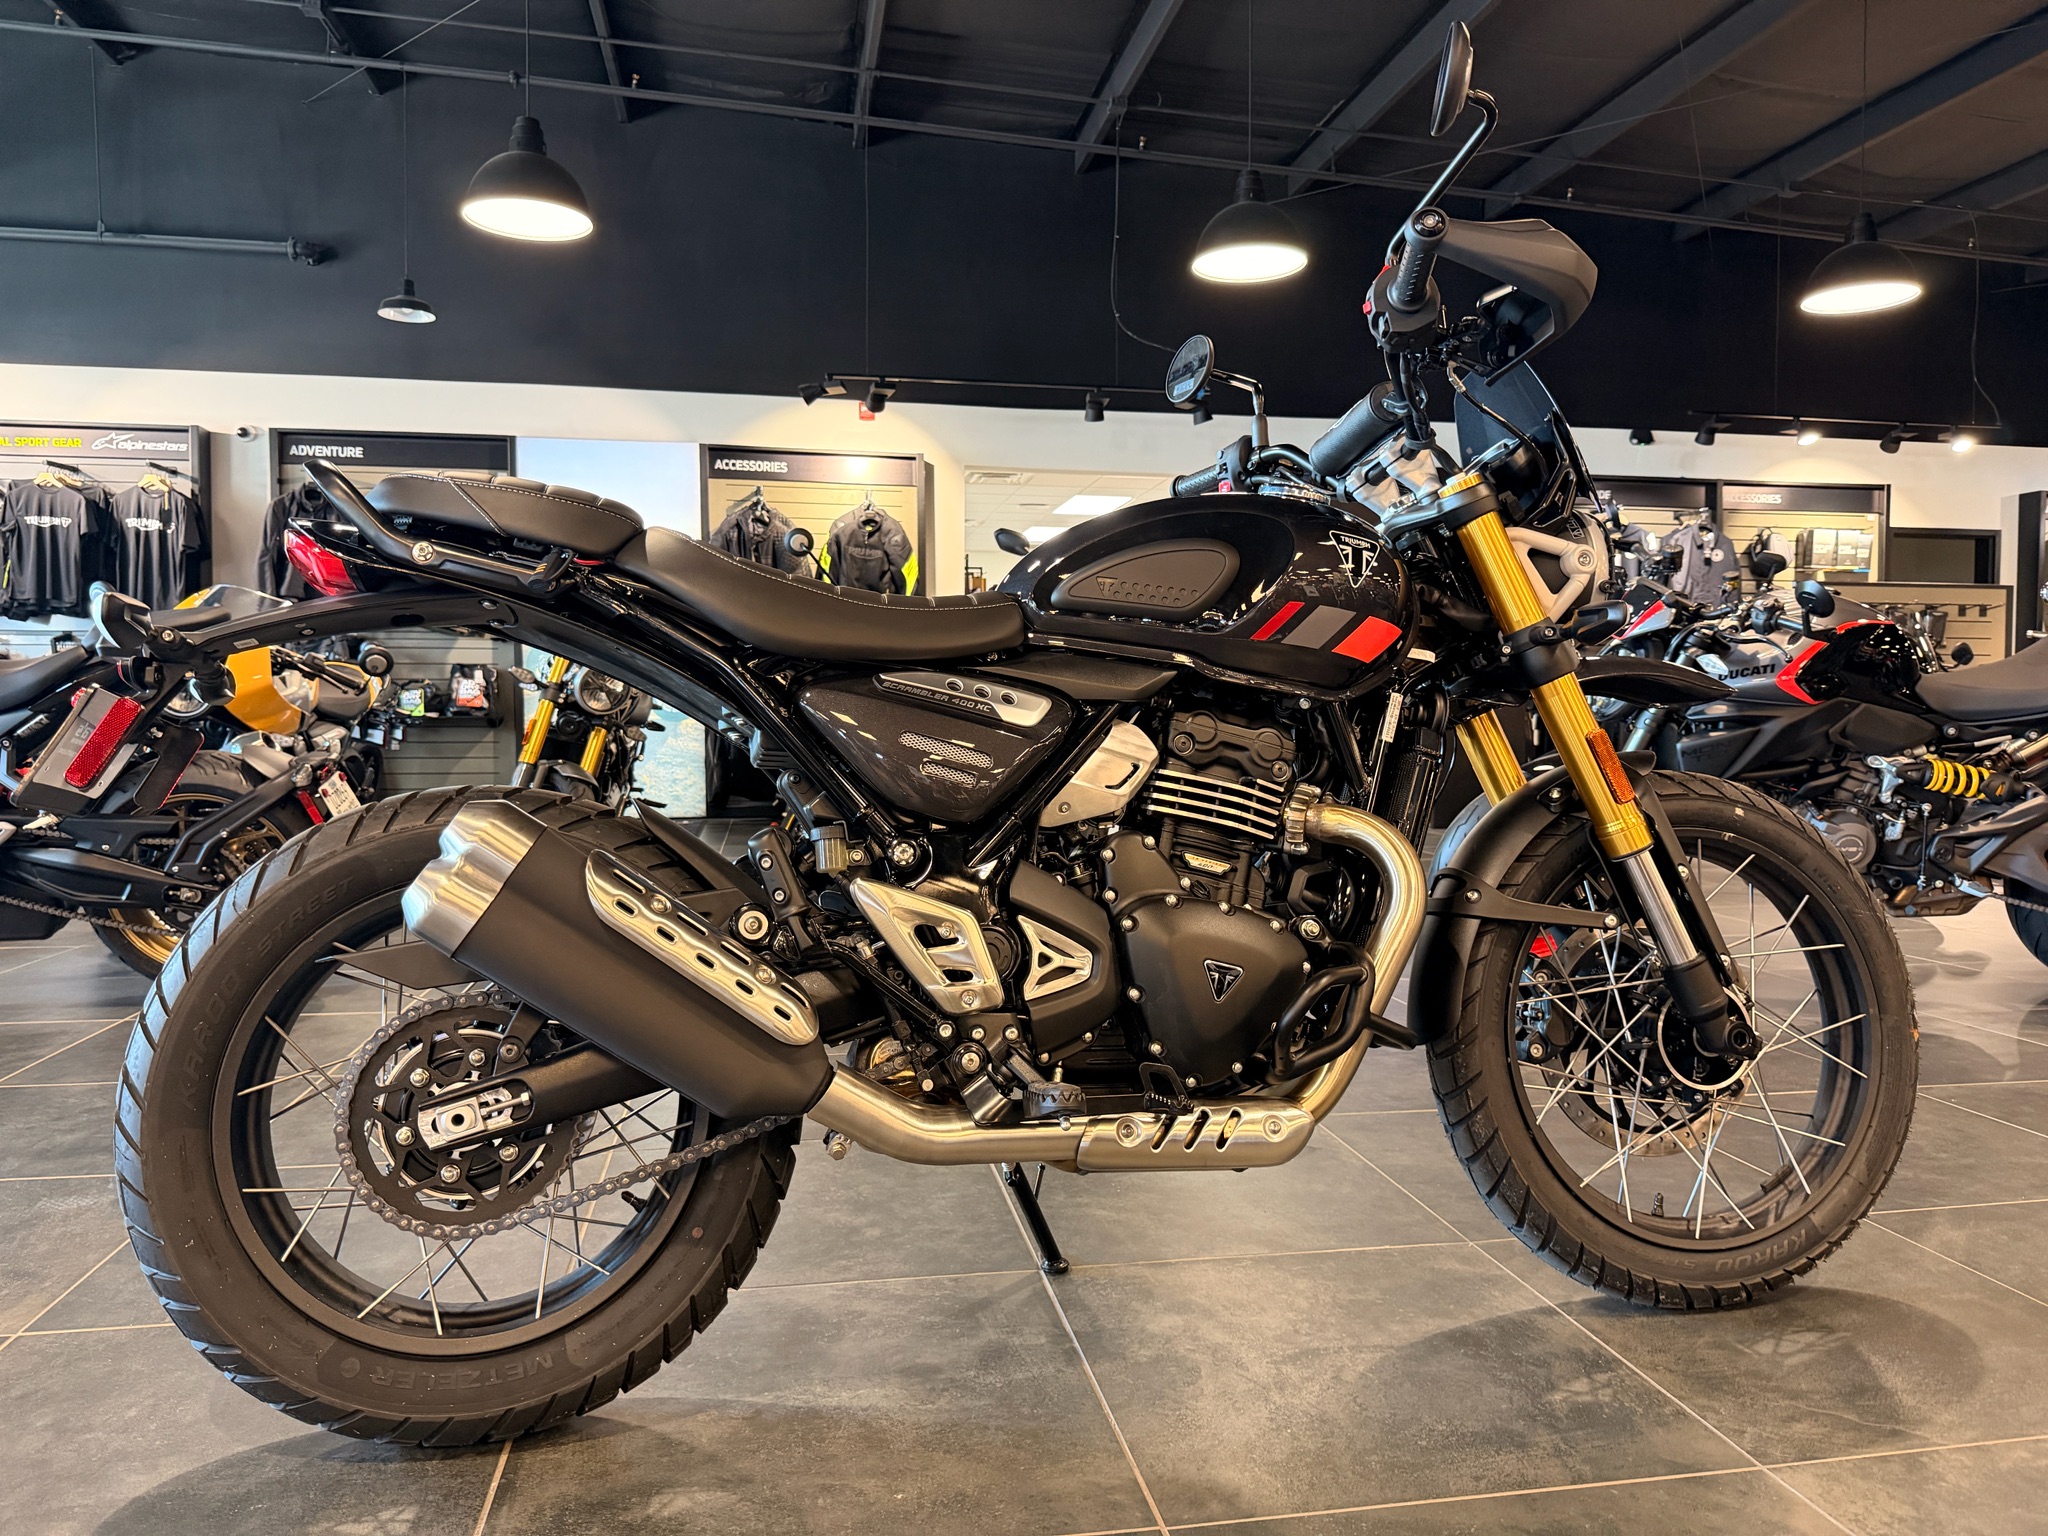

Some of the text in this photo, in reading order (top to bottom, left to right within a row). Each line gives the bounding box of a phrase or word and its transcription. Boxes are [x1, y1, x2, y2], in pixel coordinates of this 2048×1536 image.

[14, 436, 50, 448] SPORT
[51, 437, 82, 448] GEAR
[117, 439, 188, 451] alpinestars
[289, 444, 364, 458] ADVENTURE
[714, 458, 789, 473] ACCESSORIES
[125, 517, 164, 531] TRIMPH
[1340, 535, 1371, 549] TRIUMPH
[1718, 663, 1776, 681] DUCATI
[882, 680, 992, 713] SCRAMBLER 400 XC
[258, 875, 355, 956] STREET
[1715, 1227, 1807, 1273] KAROO
[371, 1354, 554, 1390] METZELER
